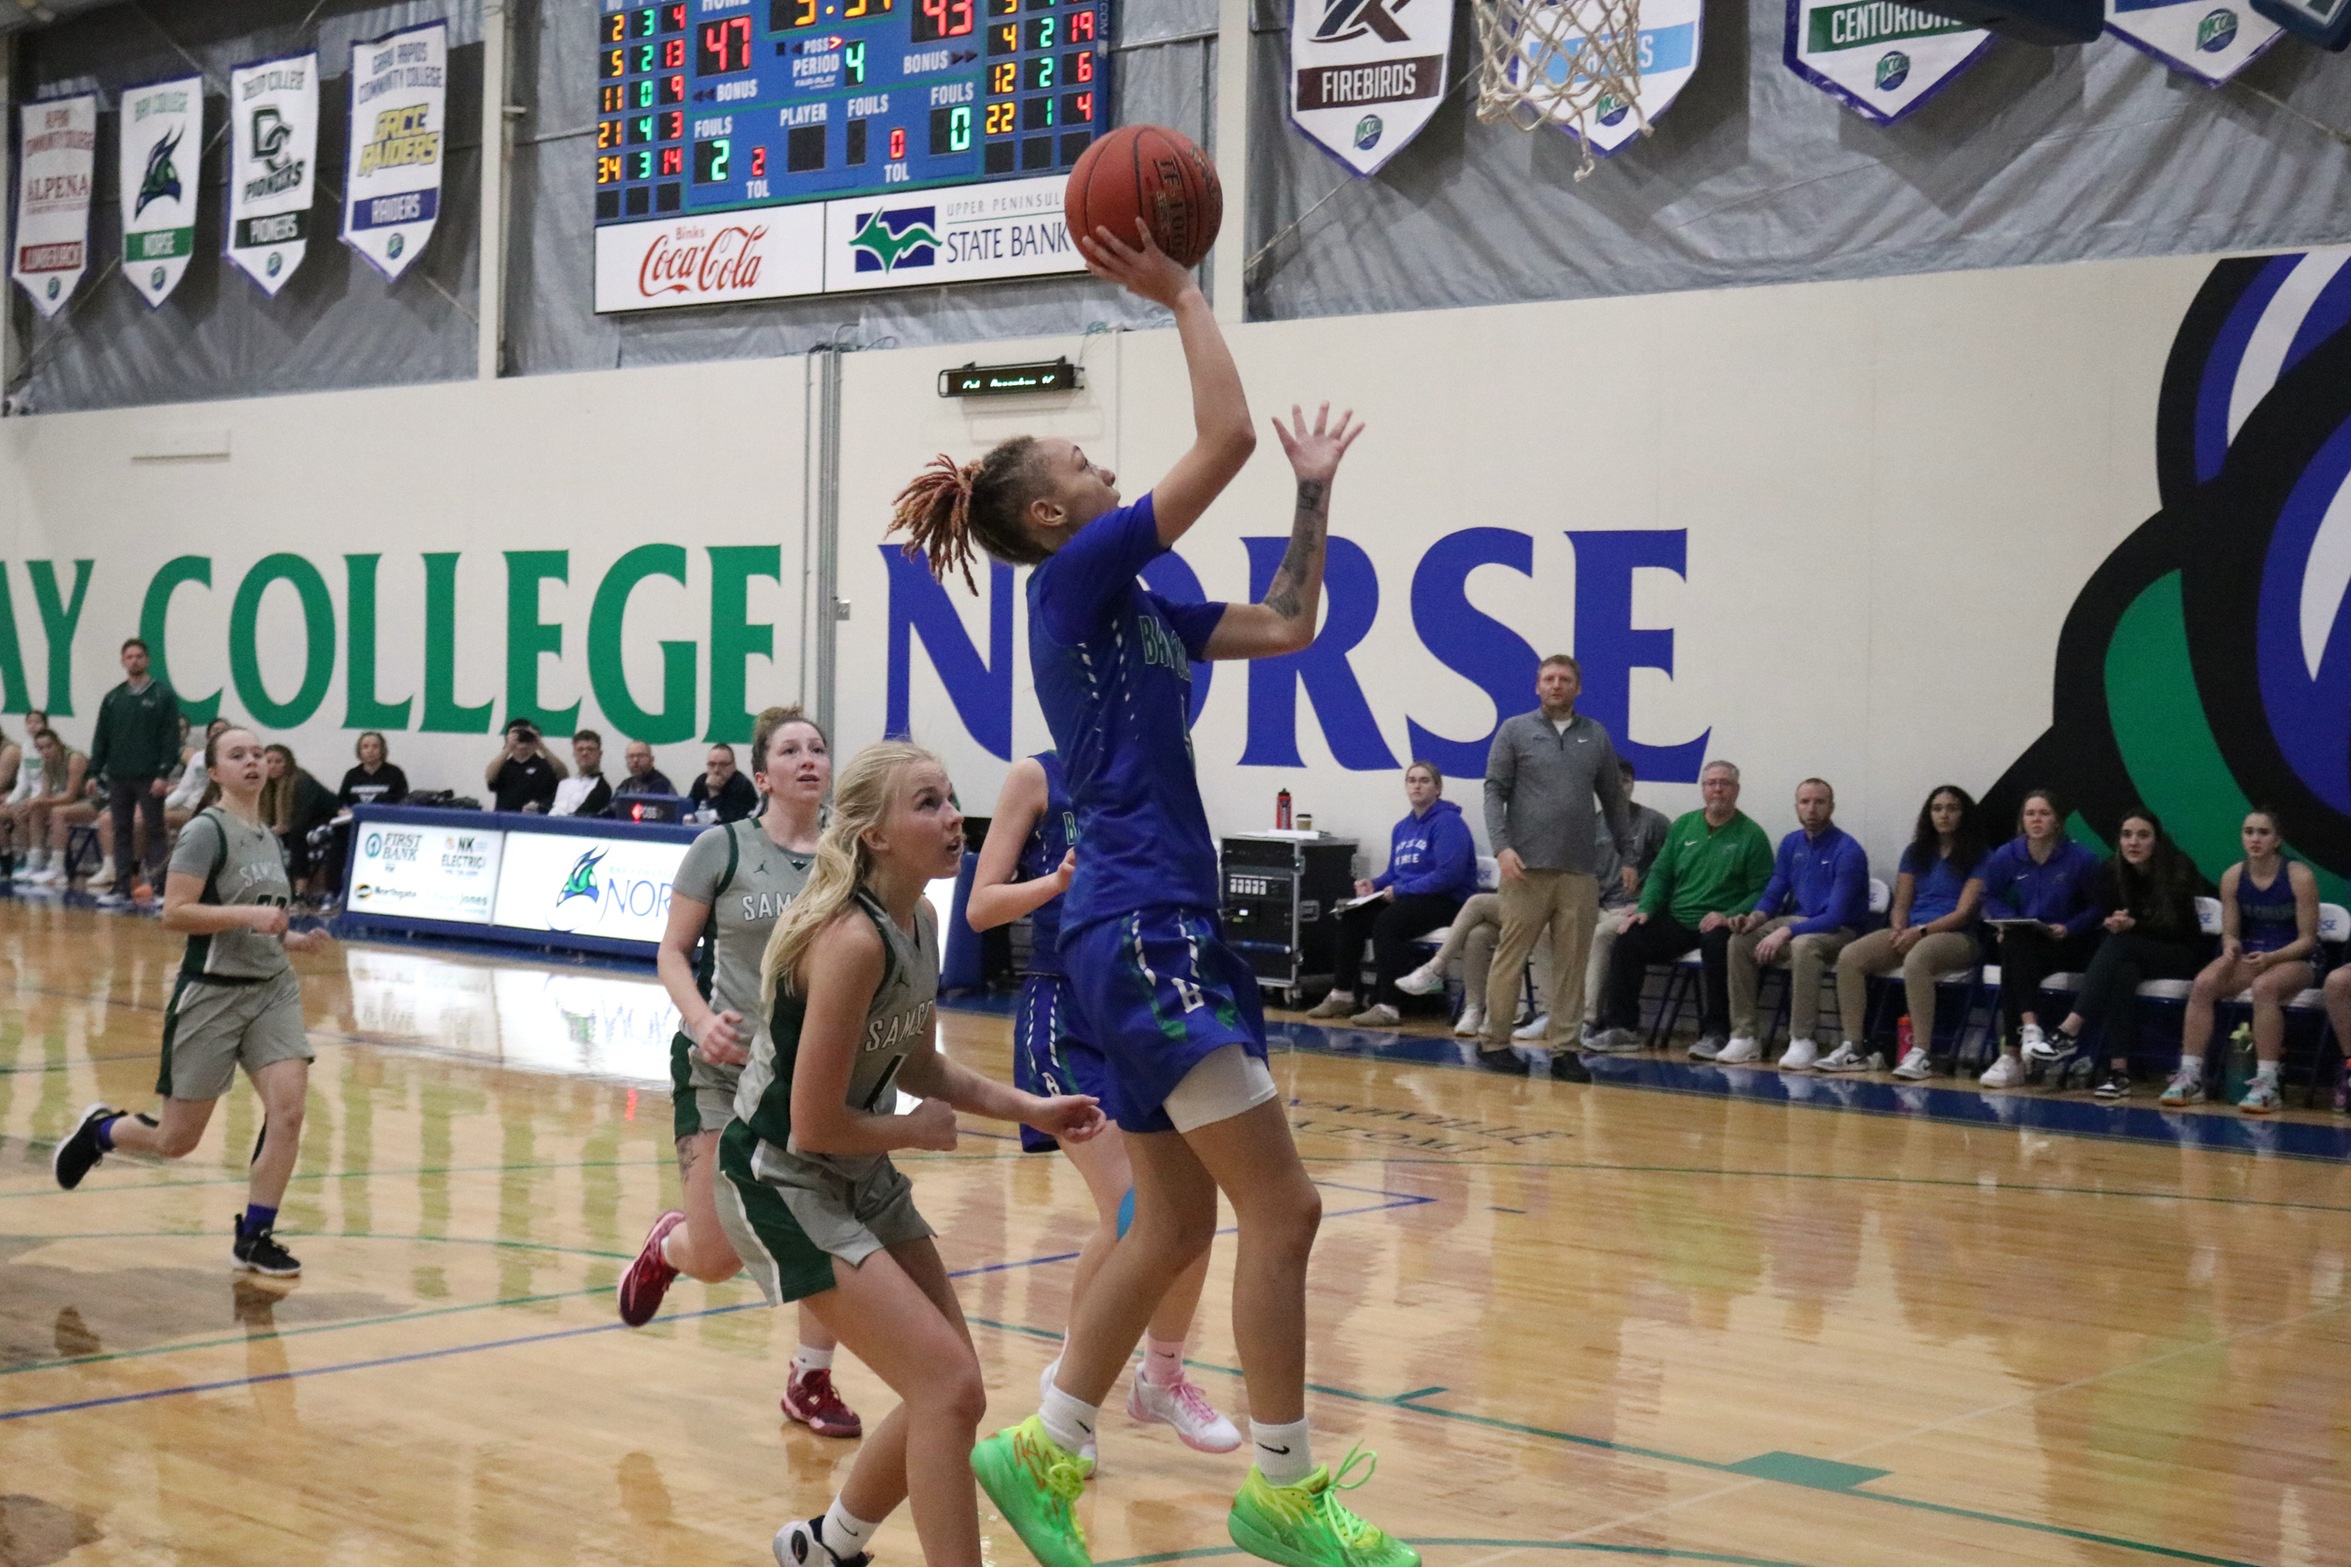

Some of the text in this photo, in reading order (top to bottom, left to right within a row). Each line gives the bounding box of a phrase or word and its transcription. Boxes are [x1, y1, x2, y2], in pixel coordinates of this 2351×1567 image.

[612, 3, 686, 41] 2 3 4
[1002, 11, 1094, 51] 4 2 19
[1832, 2, 1963, 44] CENTURI
[611, 39, 685, 77] 5 2 13
[706, 17, 751, 72] 47
[803, 37, 830, 55] POSS
[846, 42, 865, 83] 4
[903, 50, 949, 75] BONUS
[792, 54, 840, 78] PERIOD
[995, 51, 1093, 93] 12 2 6
[1322, 63, 1416, 104] FIREBIRDS
[604, 74, 685, 112] 11 0 9
[716, 79, 758, 103] BONUS
[931, 82, 974, 106] FOULS
[694, 116, 732, 139] FOULS
[780, 94, 889, 127] PLAYER FOULS
[950, 105, 971, 152] 0
[986, 92, 1092, 135] 22 1 4
[598, 110, 683, 149] 21 4 3
[890, 128, 905, 160] 0
[597, 148, 683, 184] 34 3 14
[711, 139, 730, 182] 2
[752, 147, 766, 177] 2
[884, 163, 910, 183] TOL
[746, 181, 770, 200] TOL
[946, 192, 1061, 217] UPPER PENINSUL
[947, 223, 1071, 264] STATE BANK
[139, 543, 783, 744] COLLEGE
[382, 846, 419, 861] BANK
[385, 833, 423, 849] FIRST
[457, 836, 475, 853] NK
[598, 878, 673, 923] NOR
